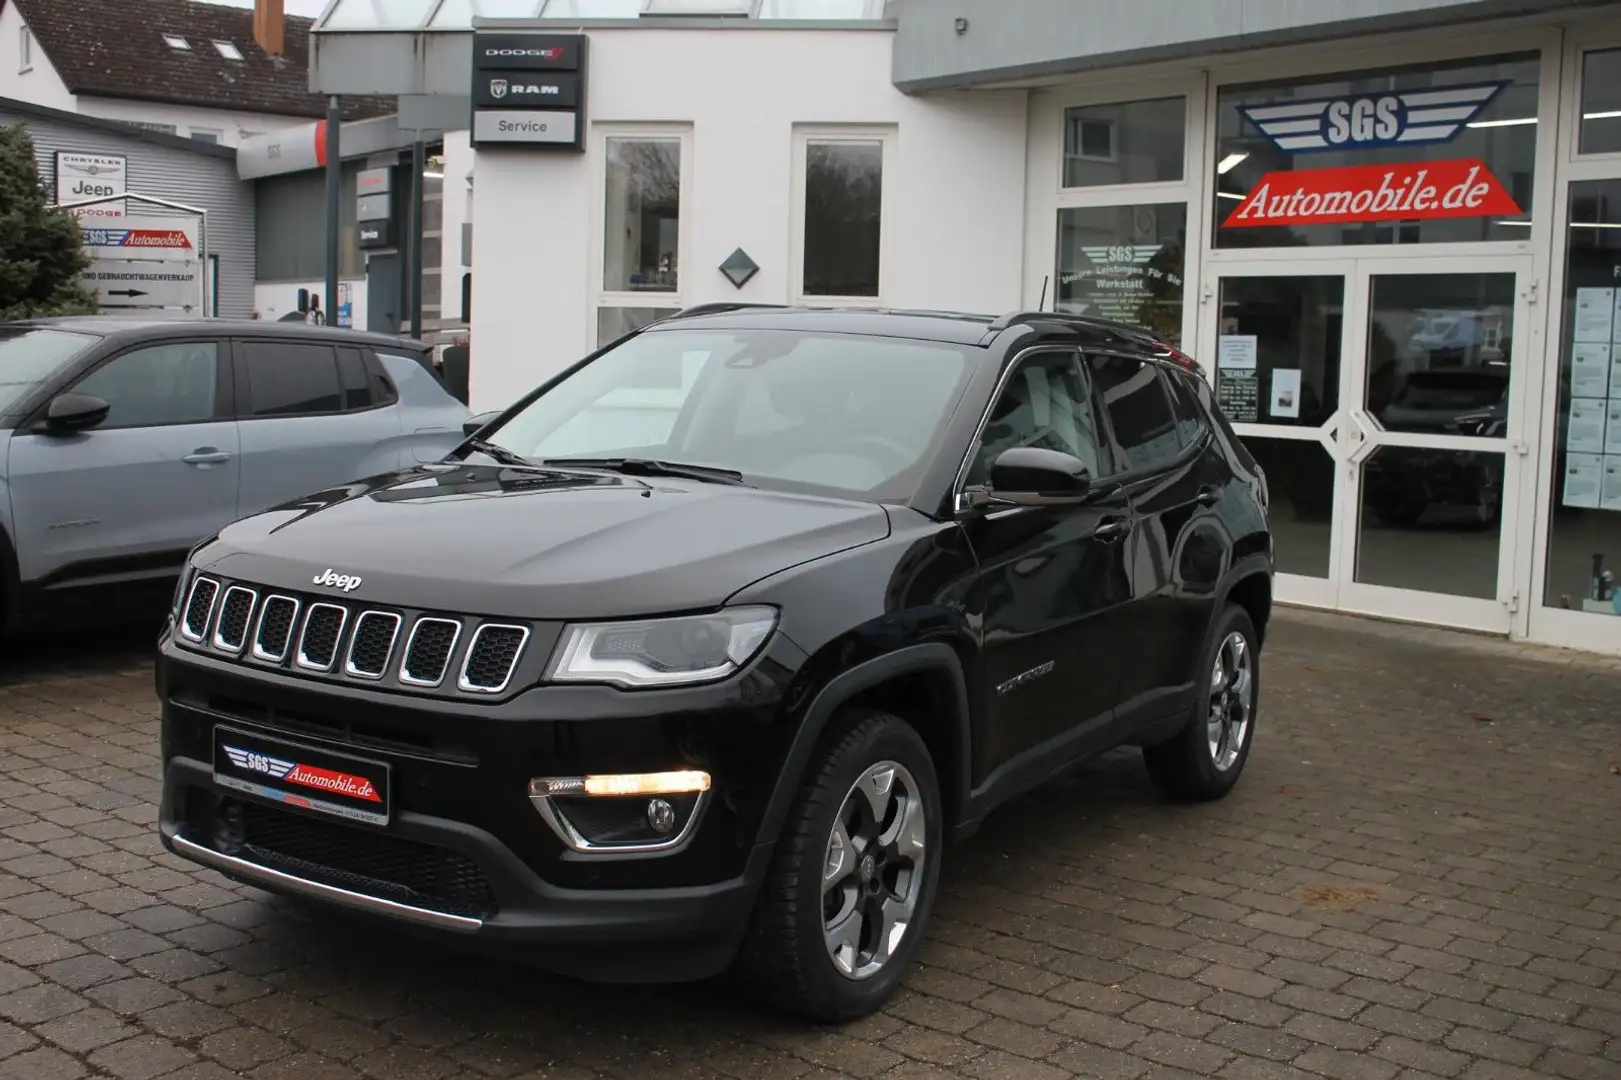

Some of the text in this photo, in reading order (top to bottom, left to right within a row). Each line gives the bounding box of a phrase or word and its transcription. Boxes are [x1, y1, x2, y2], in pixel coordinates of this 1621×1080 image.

[485, 49, 554, 57] DODGE
[511, 85, 559, 94] RAM
[498, 120, 548, 132] Service
[1328, 96, 1399, 143] SGS
[63, 156, 121, 165] CHRYSLER
[72, 180, 114, 197] Jeep
[1236, 165, 1490, 220] Automobile.de
[89, 230, 185, 247] SGS Automobile
[1108, 246, 1133, 262] SGS
[1096, 264, 1143, 277] Leistungen
[1096, 279, 1144, 289] Werkstatt
[313, 568, 362, 593] Jeep
[247, 753, 373, 797] SGS Automobile.de
